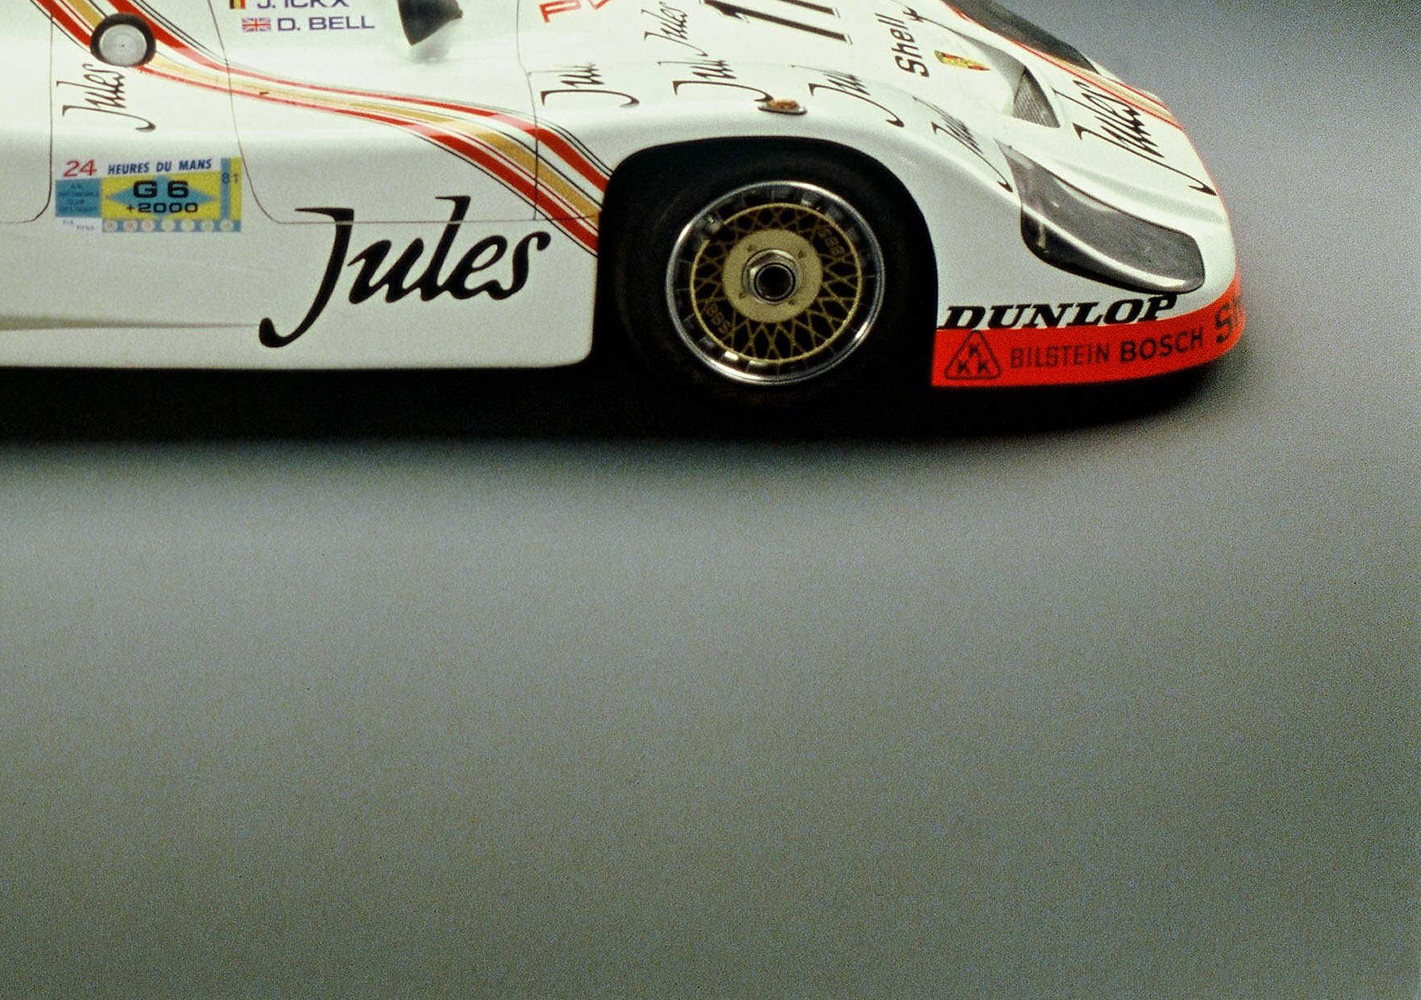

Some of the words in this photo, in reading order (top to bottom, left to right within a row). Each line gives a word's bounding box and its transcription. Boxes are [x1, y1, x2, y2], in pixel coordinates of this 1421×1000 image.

[277, 16, 302, 32] D.
[309, 14, 376, 31] BELL
[874, 11, 930, 78] Shell
[55, 63, 157, 132] Jules
[62, 159, 97, 178] 24
[107, 161, 150, 176] HEURES
[156, 161, 172, 172] DU
[180, 158, 213, 170] MANS
[258, 195, 552, 349] Jules
[936, 293, 1178, 331] DUNLOP
[1009, 343, 1111, 370] BILSTEIN
[1119, 326, 1205, 365] BOSCH
